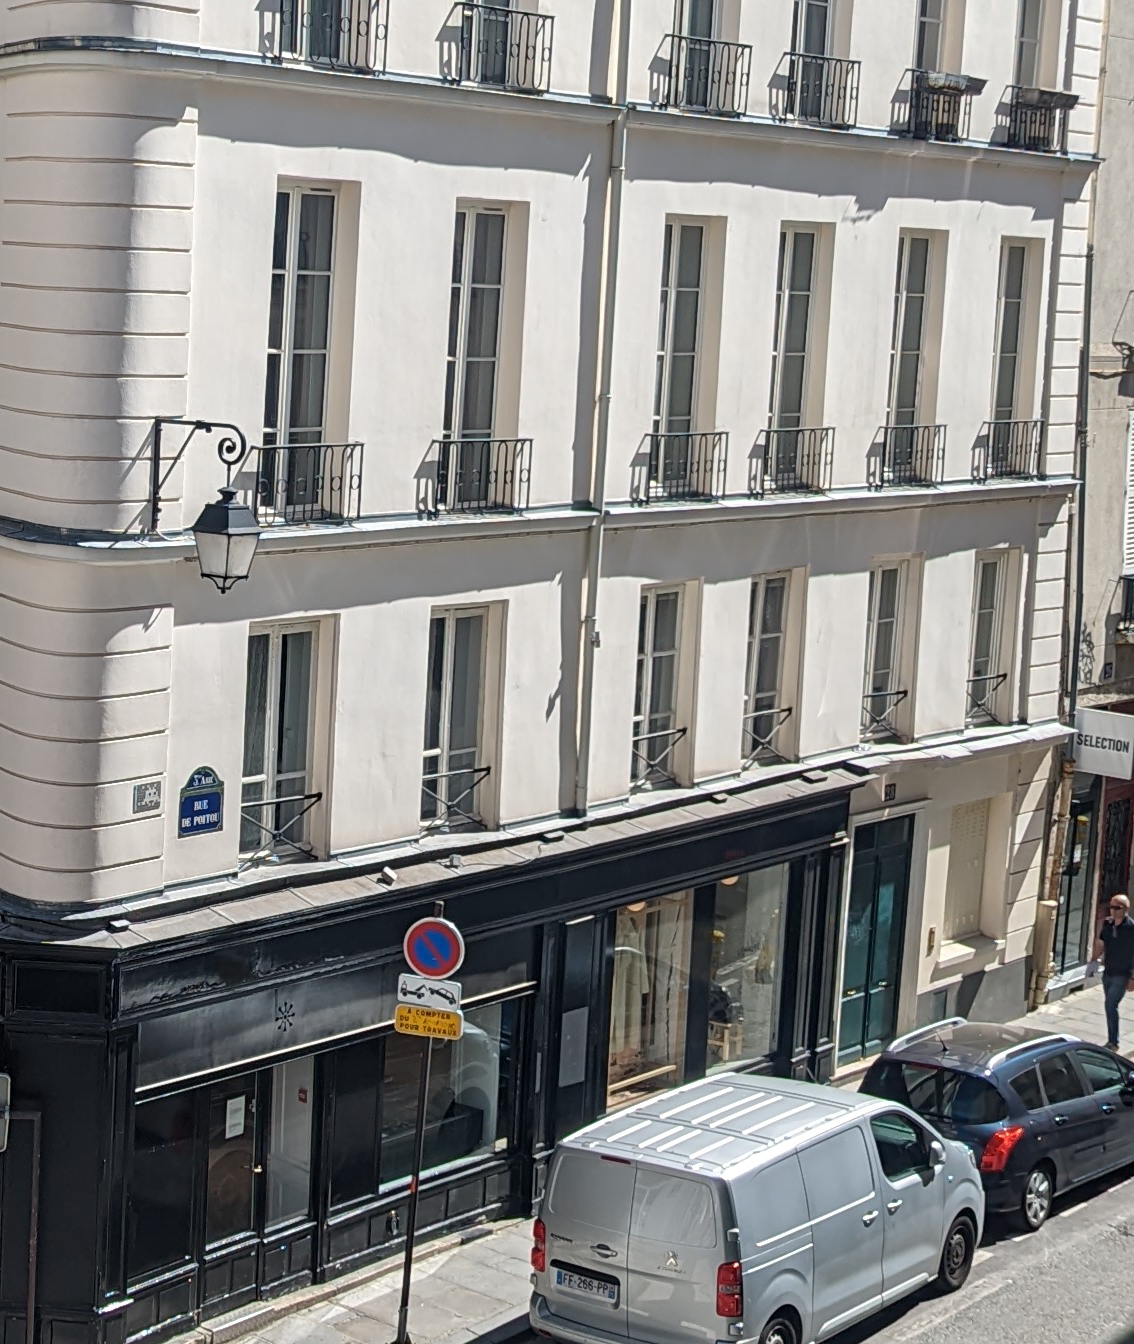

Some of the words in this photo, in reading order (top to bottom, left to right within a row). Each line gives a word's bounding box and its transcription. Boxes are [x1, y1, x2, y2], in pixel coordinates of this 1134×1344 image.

[1077, 733, 1130, 754] SELECTION
[194, 800, 209, 811] RUE
[181, 817, 192, 828] DE
[193, 812, 220, 826] POITOU
[399, 1014, 410, 1022] DU
[415, 1009, 451, 1020] COMPTER
[399, 1023, 420, 1031] POUR
[423, 1026, 457, 1036] TRAVAUX
[562, 1273, 609, 1294] FF-266-PP
